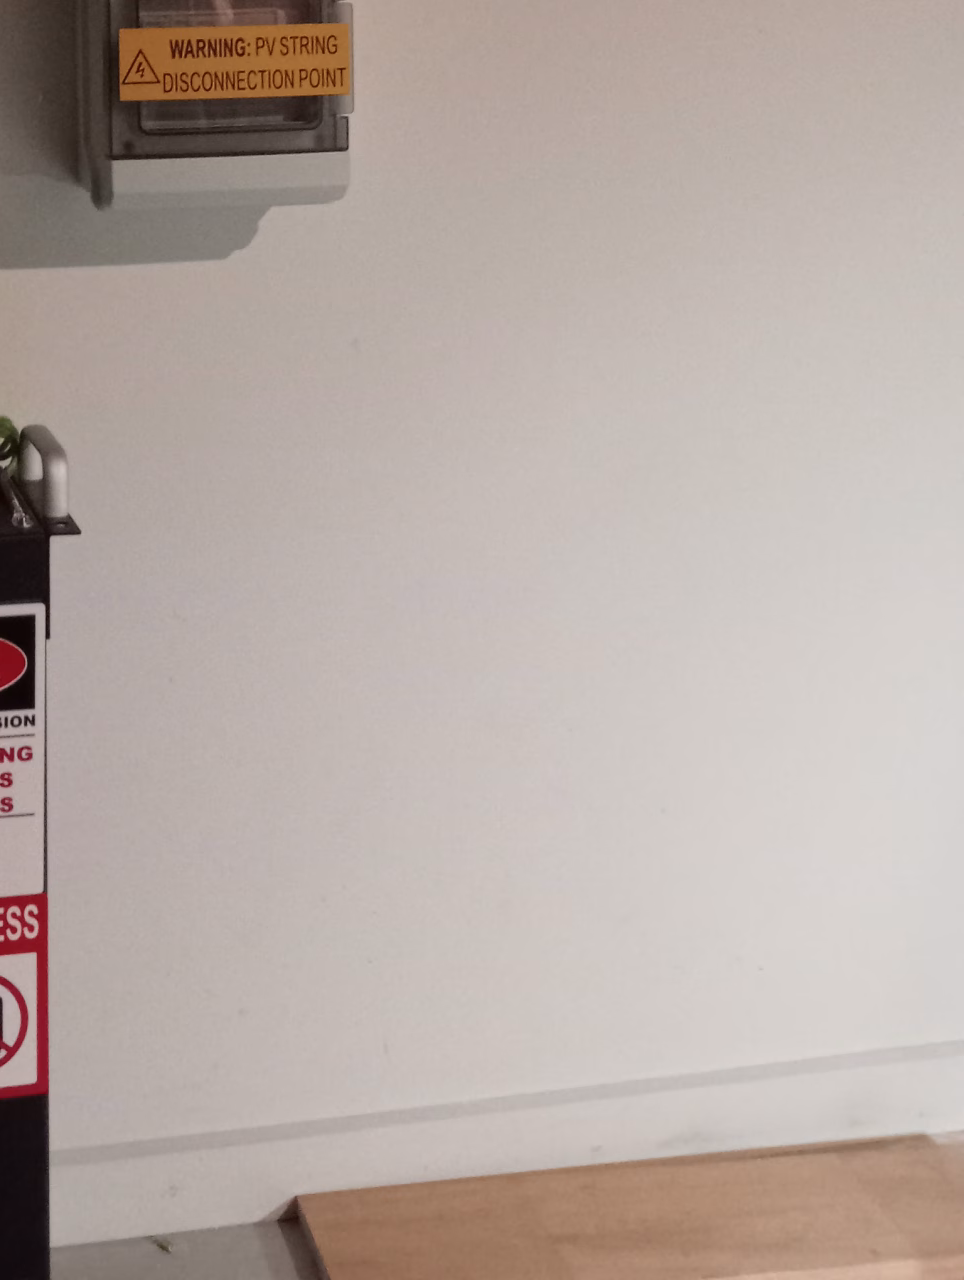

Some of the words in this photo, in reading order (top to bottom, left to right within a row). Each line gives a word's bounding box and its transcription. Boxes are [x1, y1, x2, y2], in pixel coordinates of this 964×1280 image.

[169, 37, 251, 59] WARNING:
[255, 37, 276, 57] PV
[280, 35, 338, 56] STRING
[163, 70, 295, 93] DISCONNECTION
[299, 67, 347, 88] POINT
